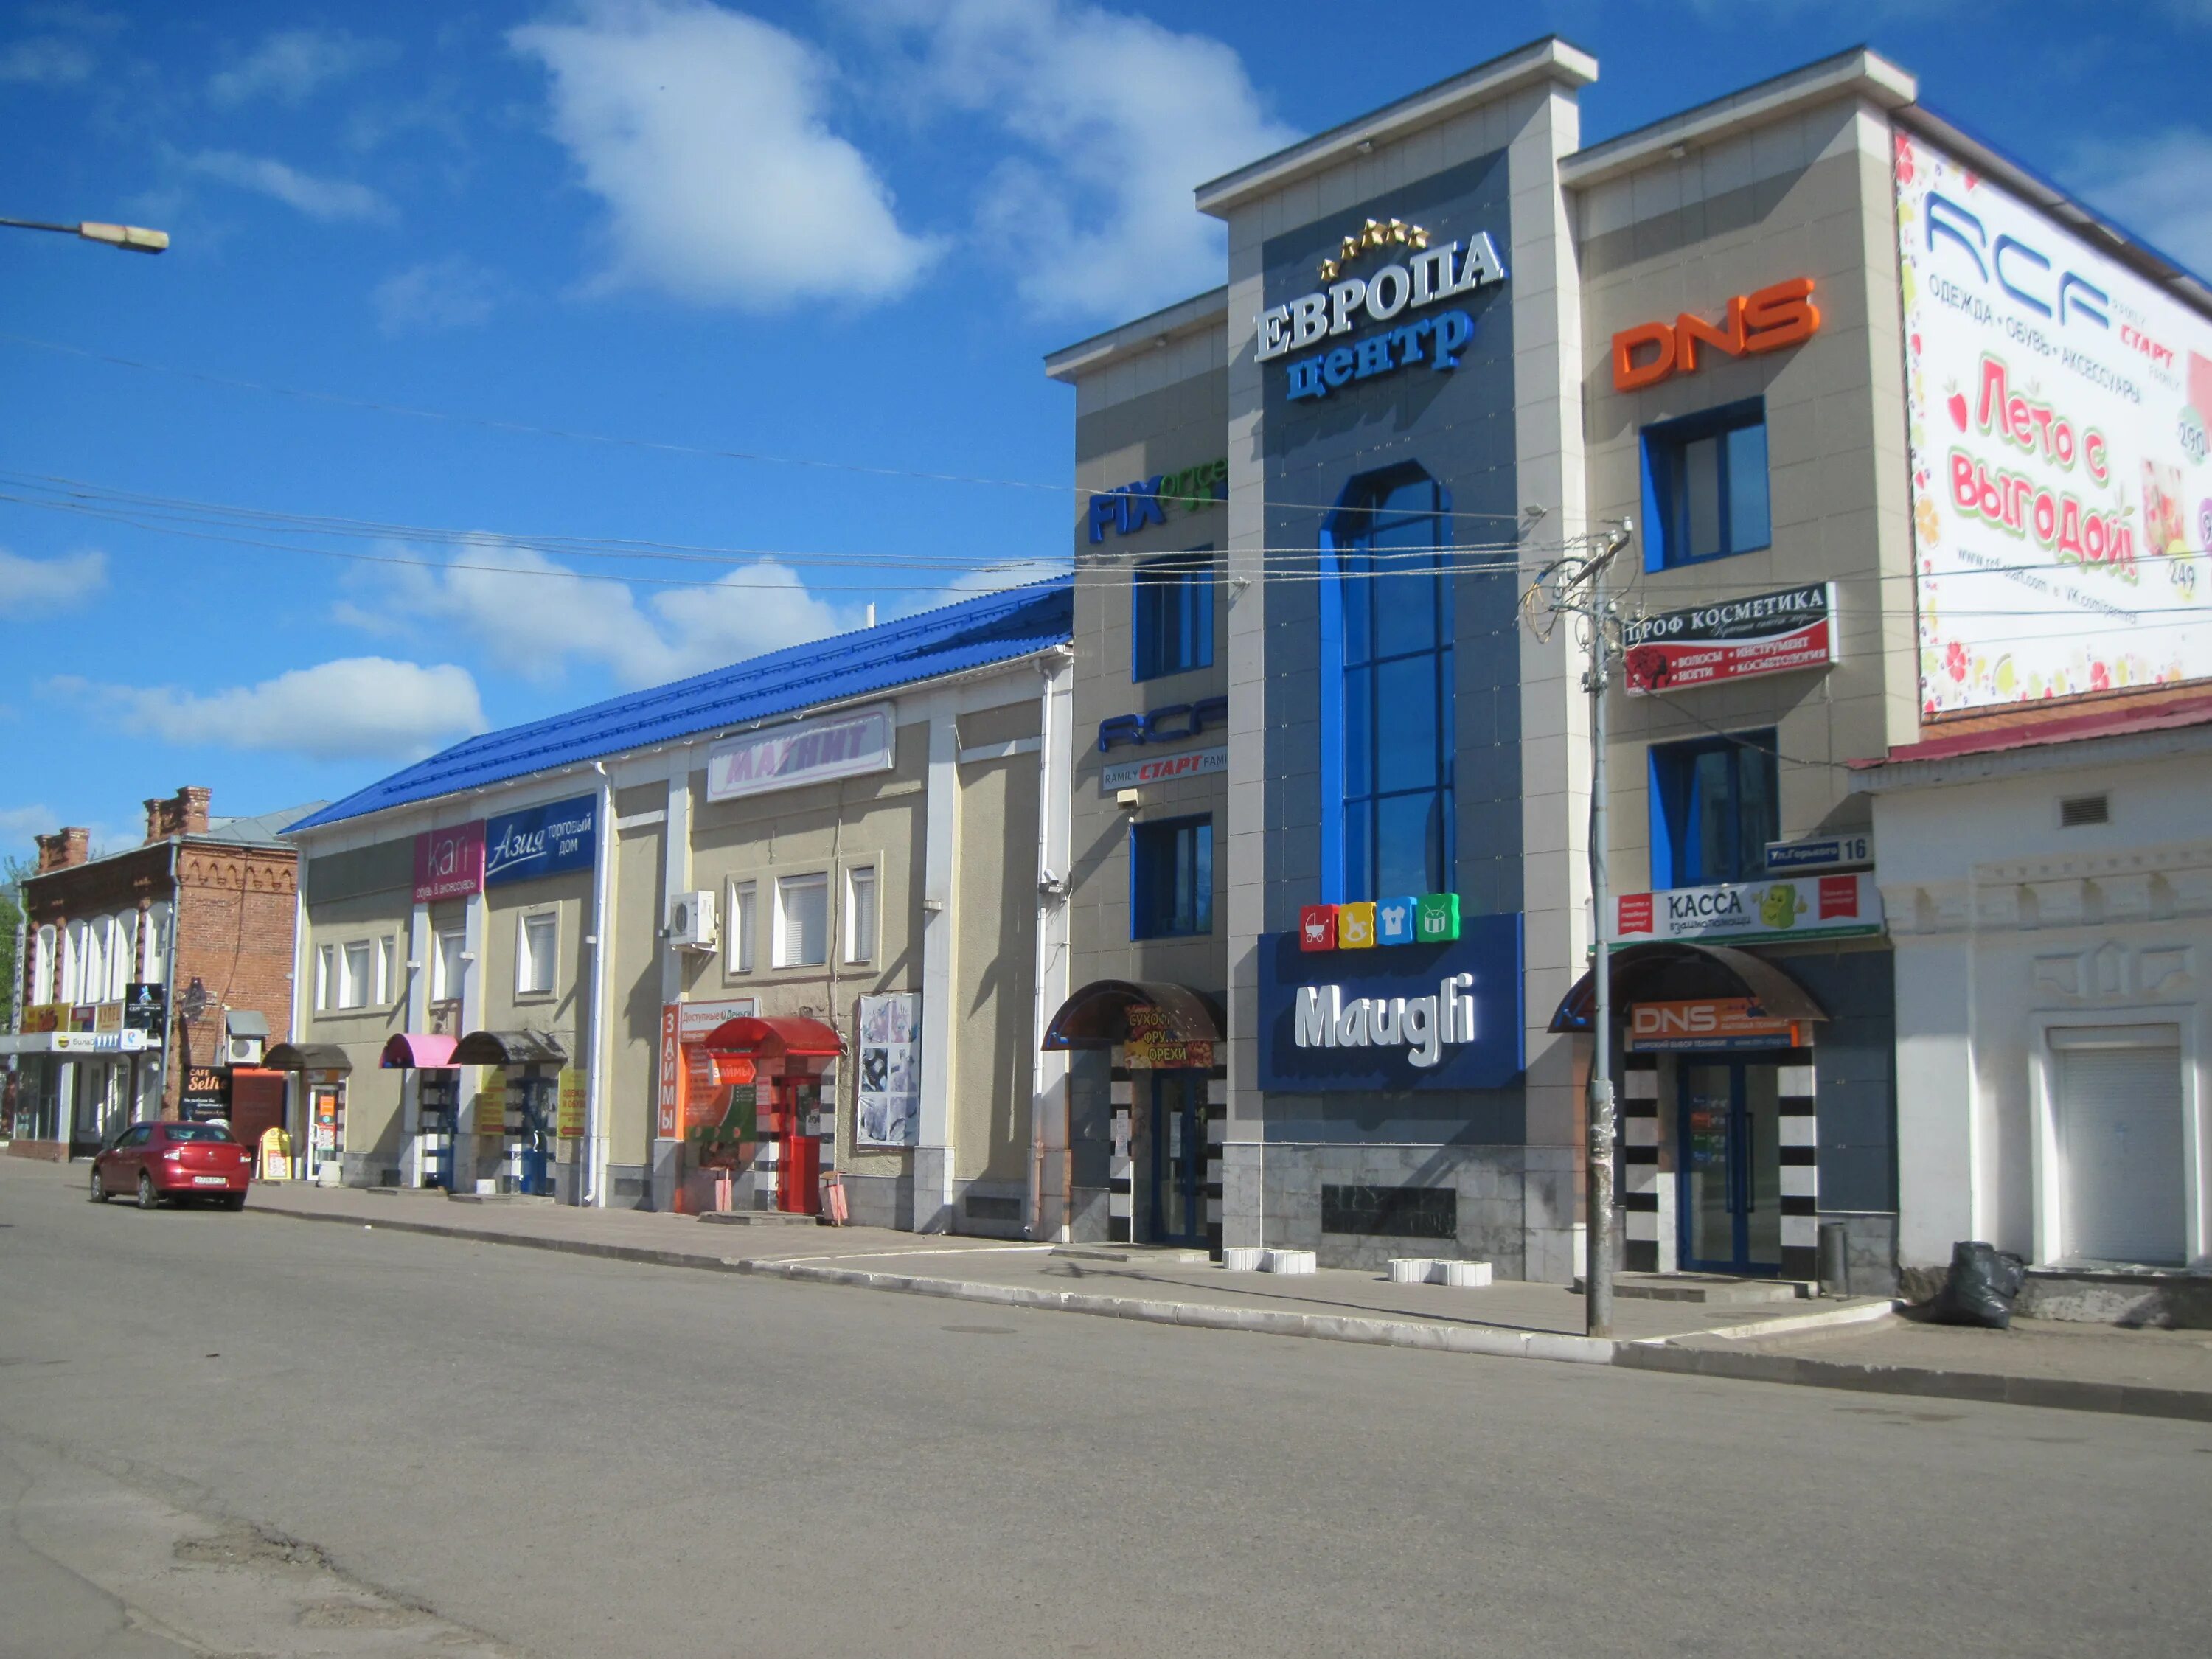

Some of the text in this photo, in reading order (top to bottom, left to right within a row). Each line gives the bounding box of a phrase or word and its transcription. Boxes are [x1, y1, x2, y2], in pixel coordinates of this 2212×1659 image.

[1254, 230, 1508, 363] ЕВРОПА
[1612, 277, 1820, 392] DNS
[1928, 274, 2141, 404] ОДЕЖДА ОБУВЬ АКСЕССУАРЫ
[2120, 324, 2175, 369] СТАРТ
[1286, 309, 1475, 401] центр
[1977, 355, 2074, 465] Лето
[1627, 589, 1823, 642] ПРОФ КОСМЕТИКА
[1678, 636, 1809, 667] ВОЛОСЫ ИНСТРУМЕНТ
[1678, 648, 1826, 681] НОГТИ КОСМЕТОЛОГИЯ
[1139, 755, 1202, 780] СТАРТ
[428, 827, 470, 877] kari
[488, 812, 591, 869] Азия торговый
[1845, 839, 1866, 860] 16
[416, 883, 432, 899] обувь
[1668, 891, 1742, 919] КАССА
[1670, 916, 1751, 934] взаимопомощи
[682, 1012, 720, 1023] Доступные
[1295, 973, 1475, 1068] Maugli
[1635, 1004, 1717, 1034] DNS
[1149, 1048, 1186, 1060] ОРЕХИ
[189, 1069, 210, 1077] CAFE
[661, 1012, 675, 1130] ЗАЙМЫ
[713, 1064, 751, 1078] ЗАЙМЫ
